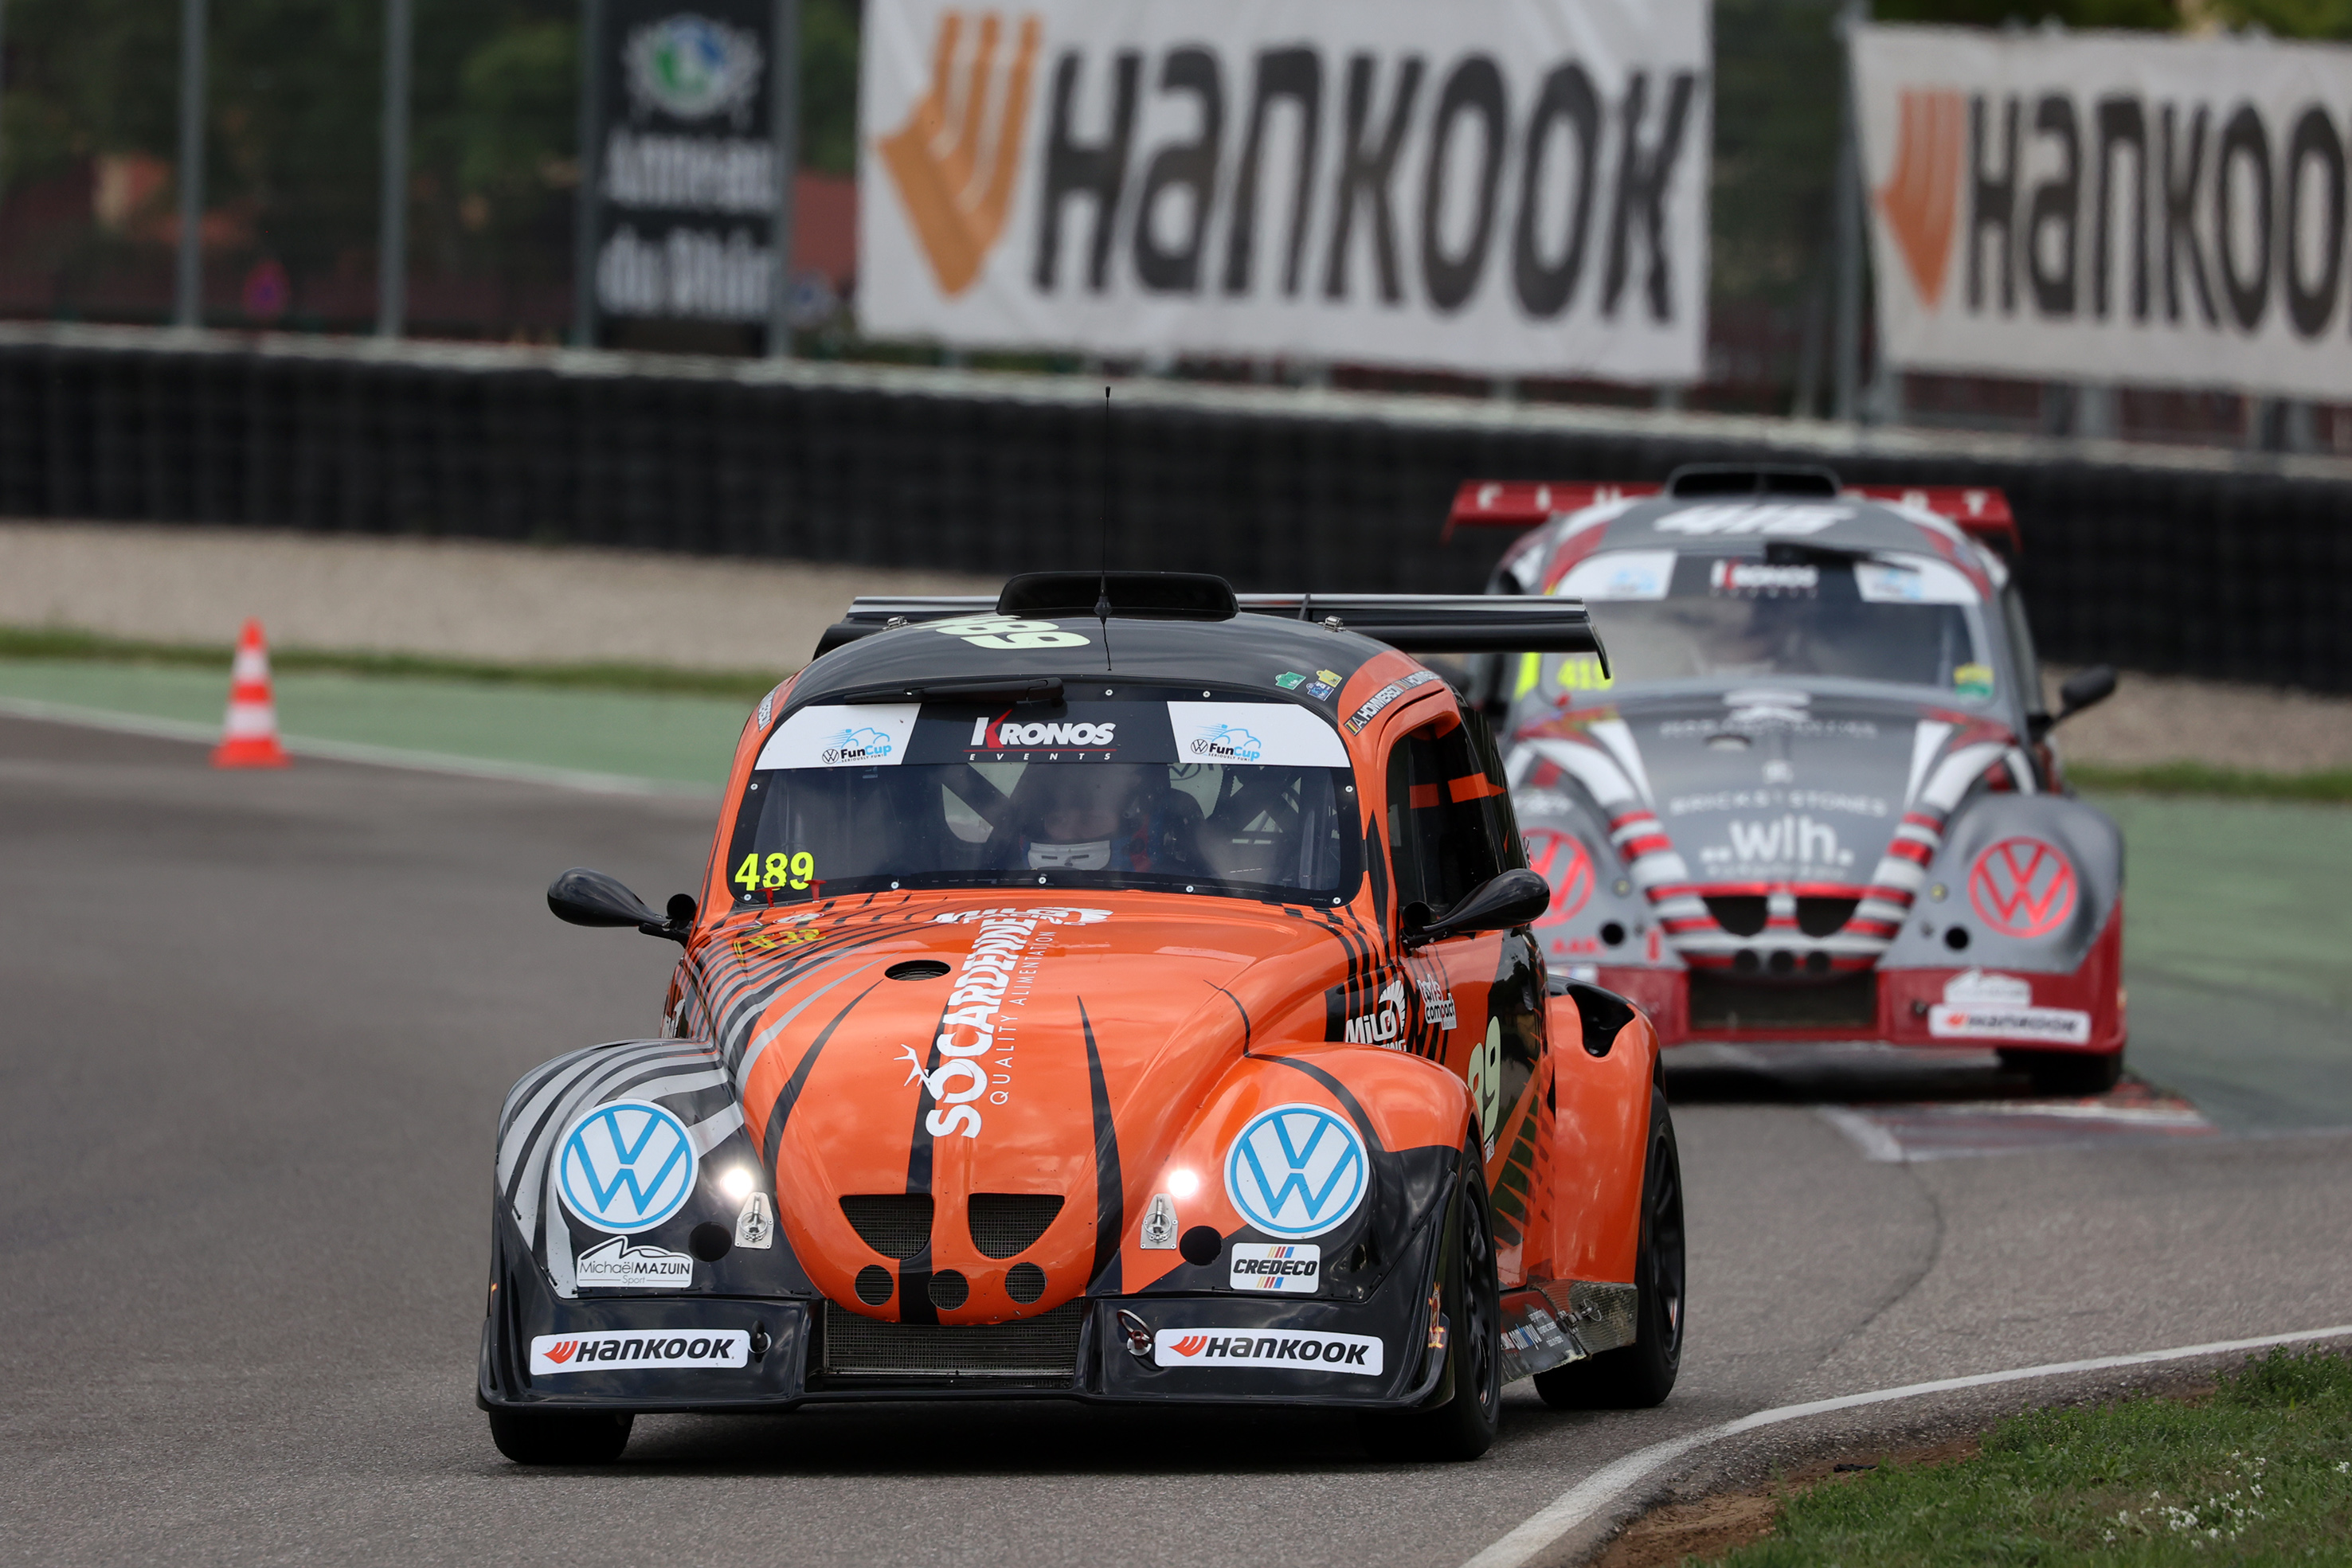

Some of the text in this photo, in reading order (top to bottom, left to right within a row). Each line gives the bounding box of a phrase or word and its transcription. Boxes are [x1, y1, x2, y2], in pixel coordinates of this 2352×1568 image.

[970, 708, 1117, 749] KRONOS
[840, 745, 892, 760] FunCup
[969, 753, 1112, 761] EVENTS
[1209, 743, 1260, 761] FunCup
[734, 851, 815, 891] 489
[989, 930, 1058, 1105] QUALITY ALIMENTATION
[1426, 995, 1455, 1028] compact
[926, 917, 1039, 1139] SOCARDENNE
[622, 1275, 646, 1285] Sport
[1233, 1259, 1318, 1277] CREDECO
